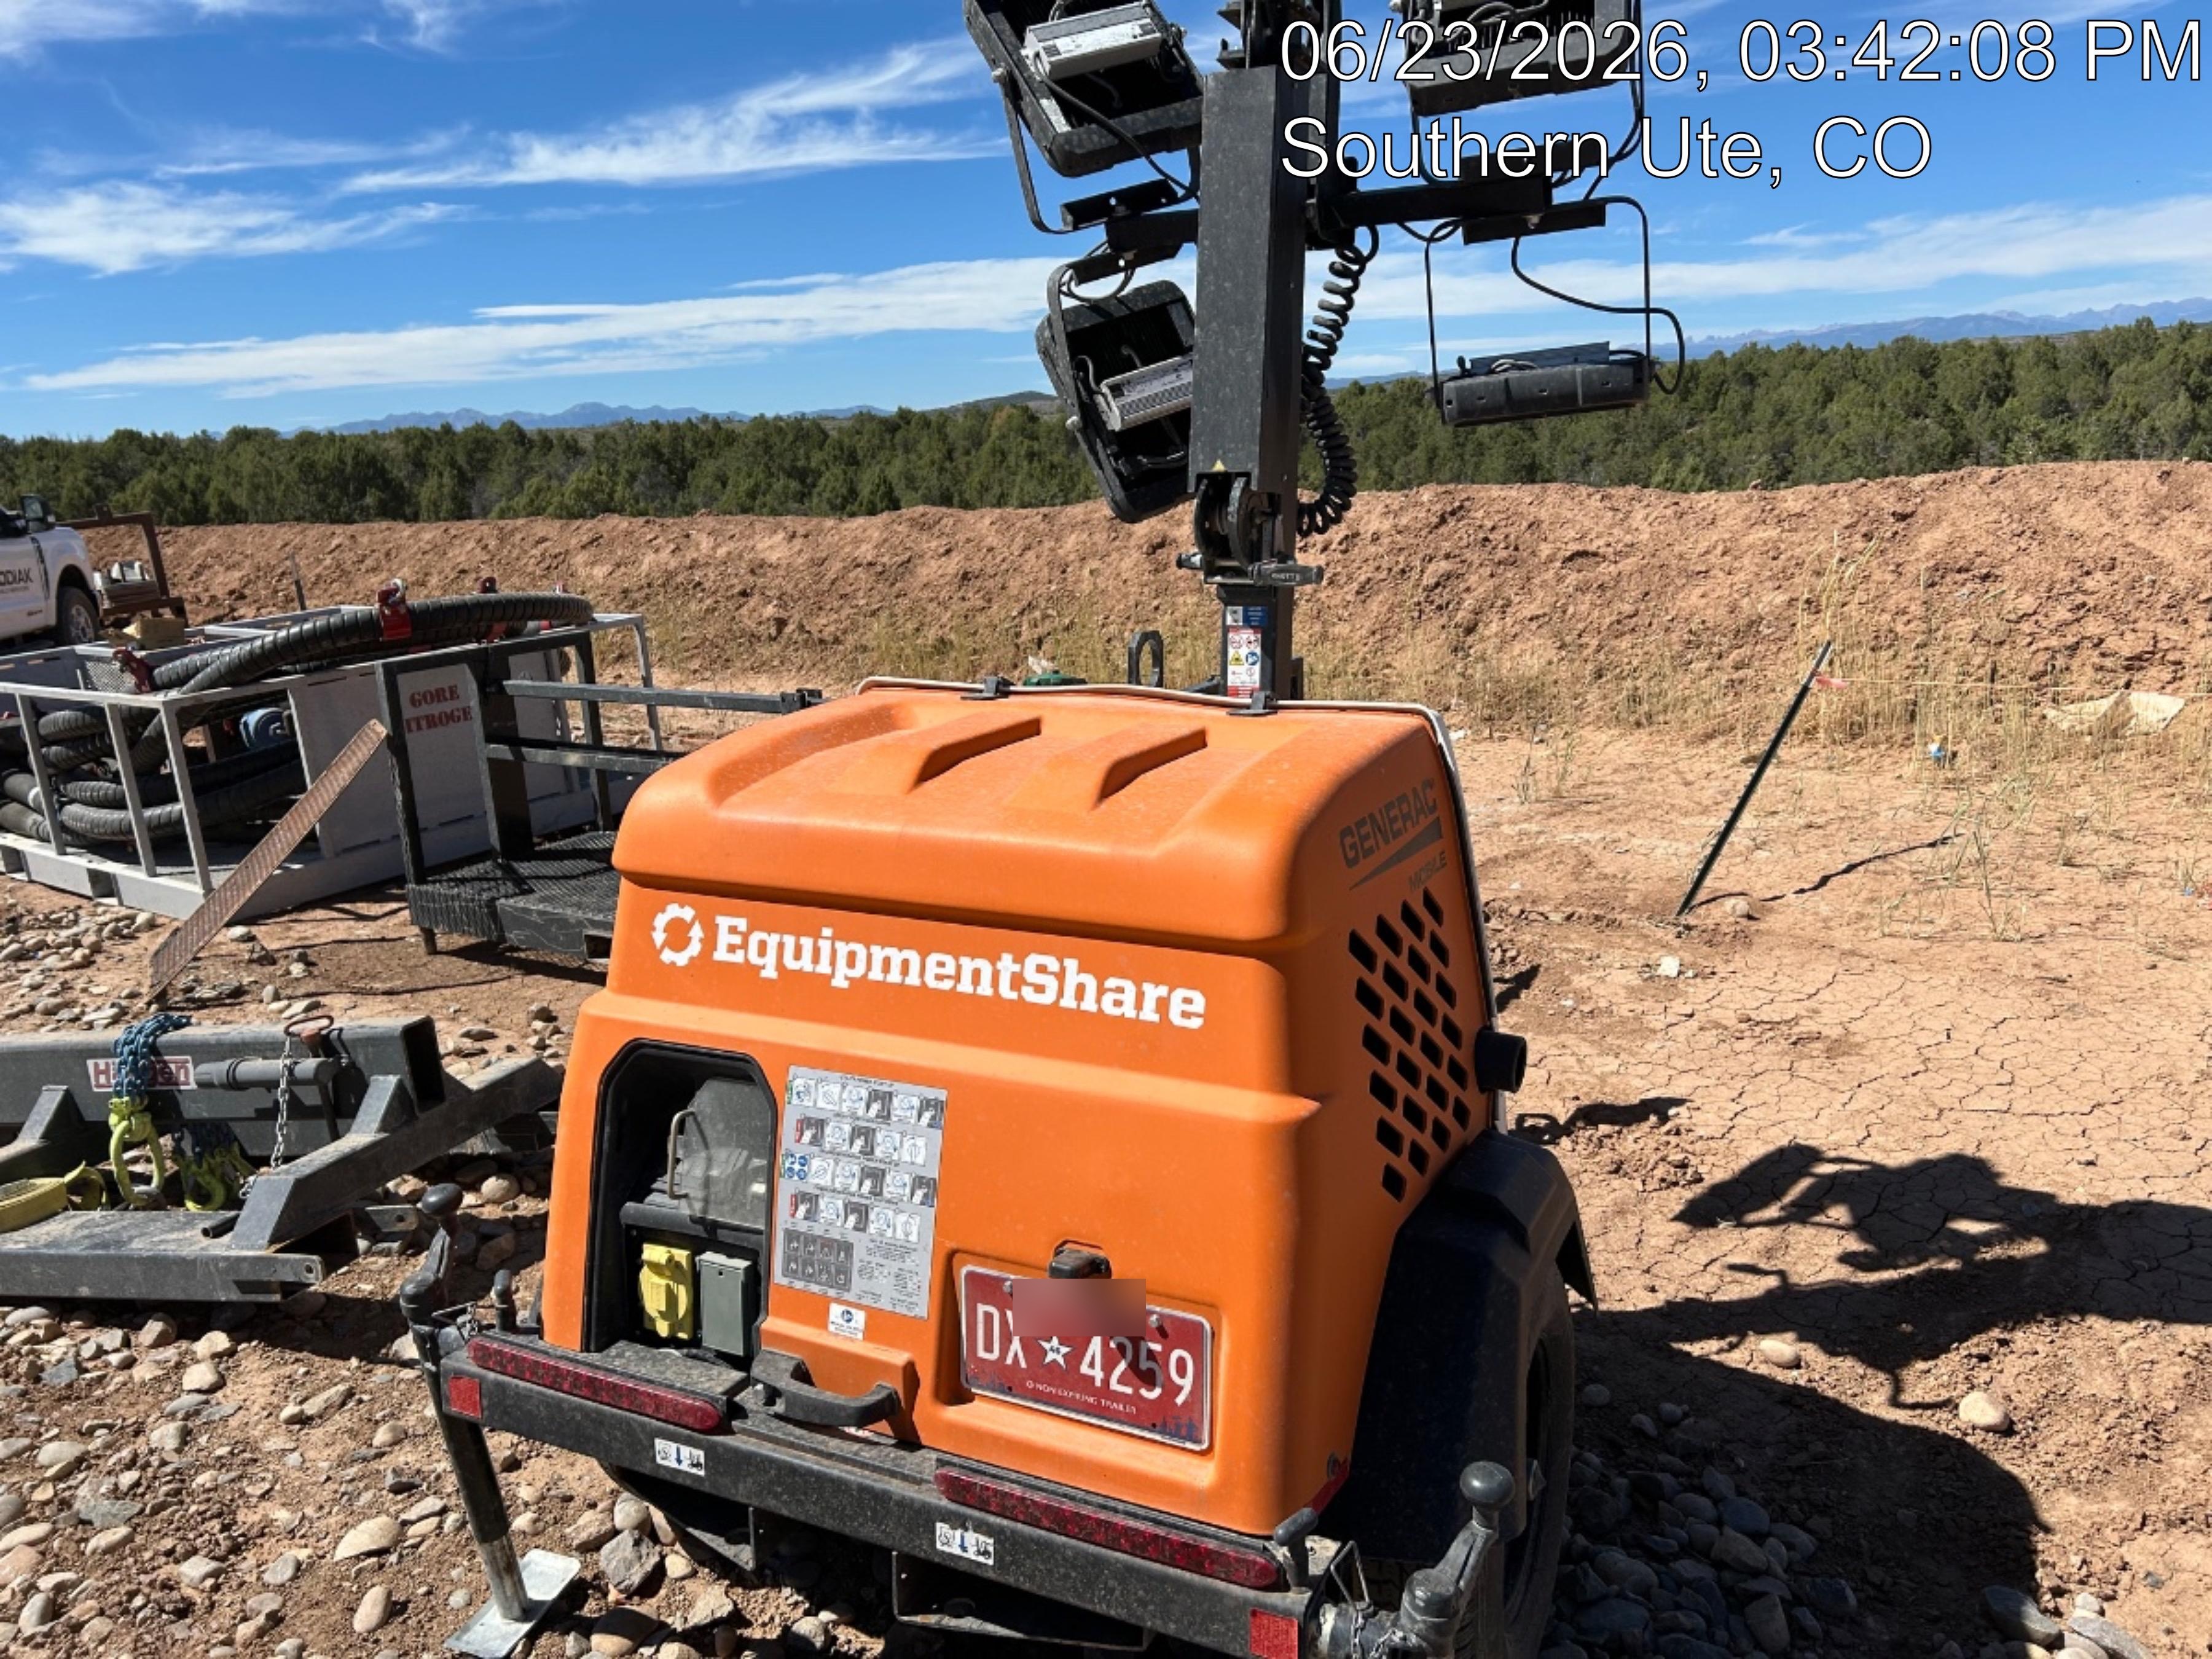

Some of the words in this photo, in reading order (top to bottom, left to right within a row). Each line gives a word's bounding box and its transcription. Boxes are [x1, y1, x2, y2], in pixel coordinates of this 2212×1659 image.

[0, 567, 33, 587] ODIAK
[409, 684, 460, 708] GORE
[406, 705, 473, 734] ITROGE
[1339, 778, 1437, 869] GENERAC
[713, 915, 1207, 1030] EquipmentShare
[1079, 1335, 1194, 1407] 4259
[1100, 1398, 1137, 1414] TRAILER
